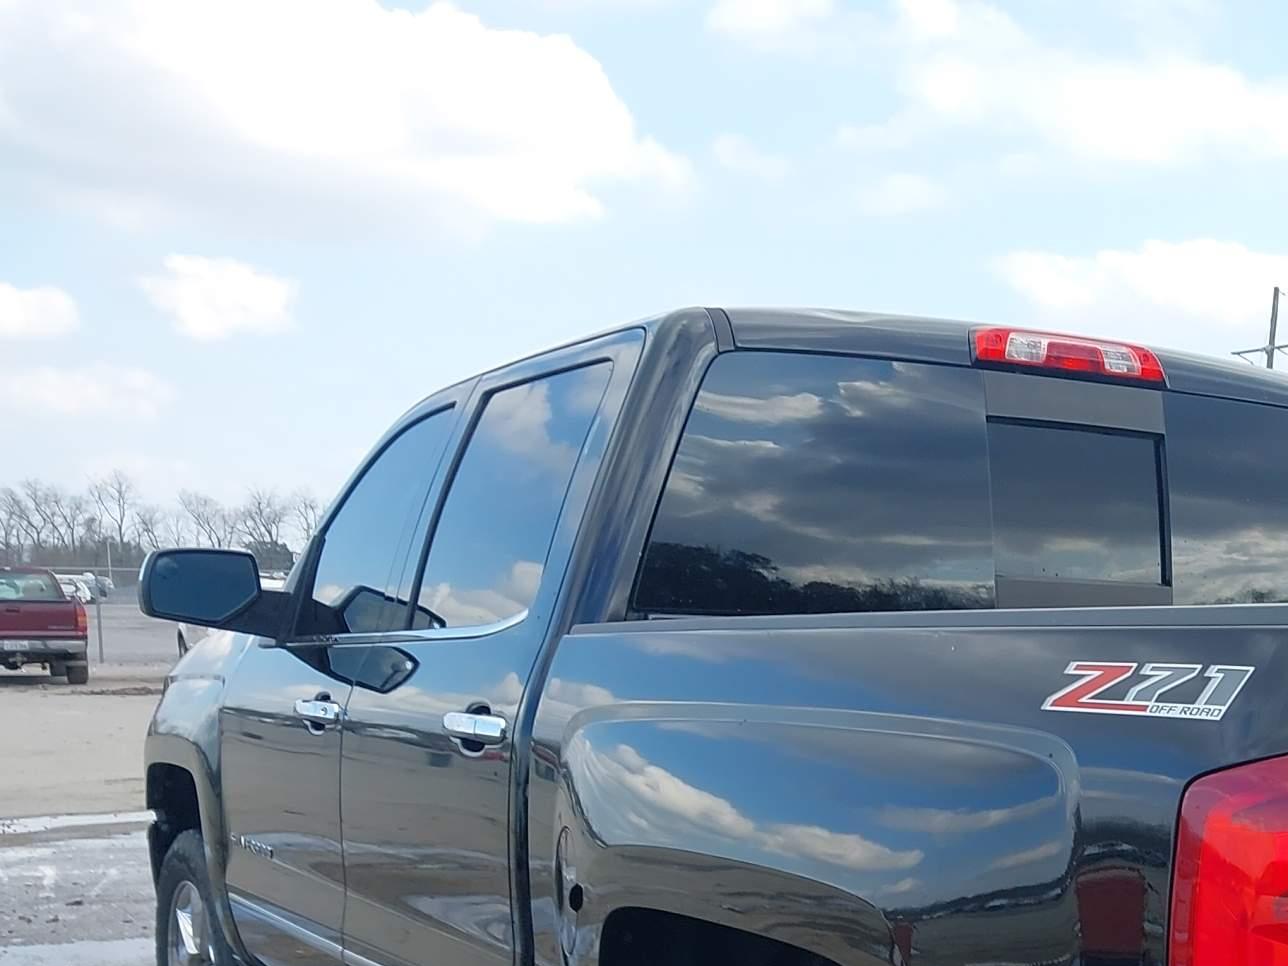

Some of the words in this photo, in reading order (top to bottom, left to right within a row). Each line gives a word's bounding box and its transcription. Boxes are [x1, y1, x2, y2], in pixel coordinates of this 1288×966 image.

[1041, 661, 1255, 711] Z71
[1149, 704, 1178, 714] OFF
[1179, 706, 1222, 717] ROAD
